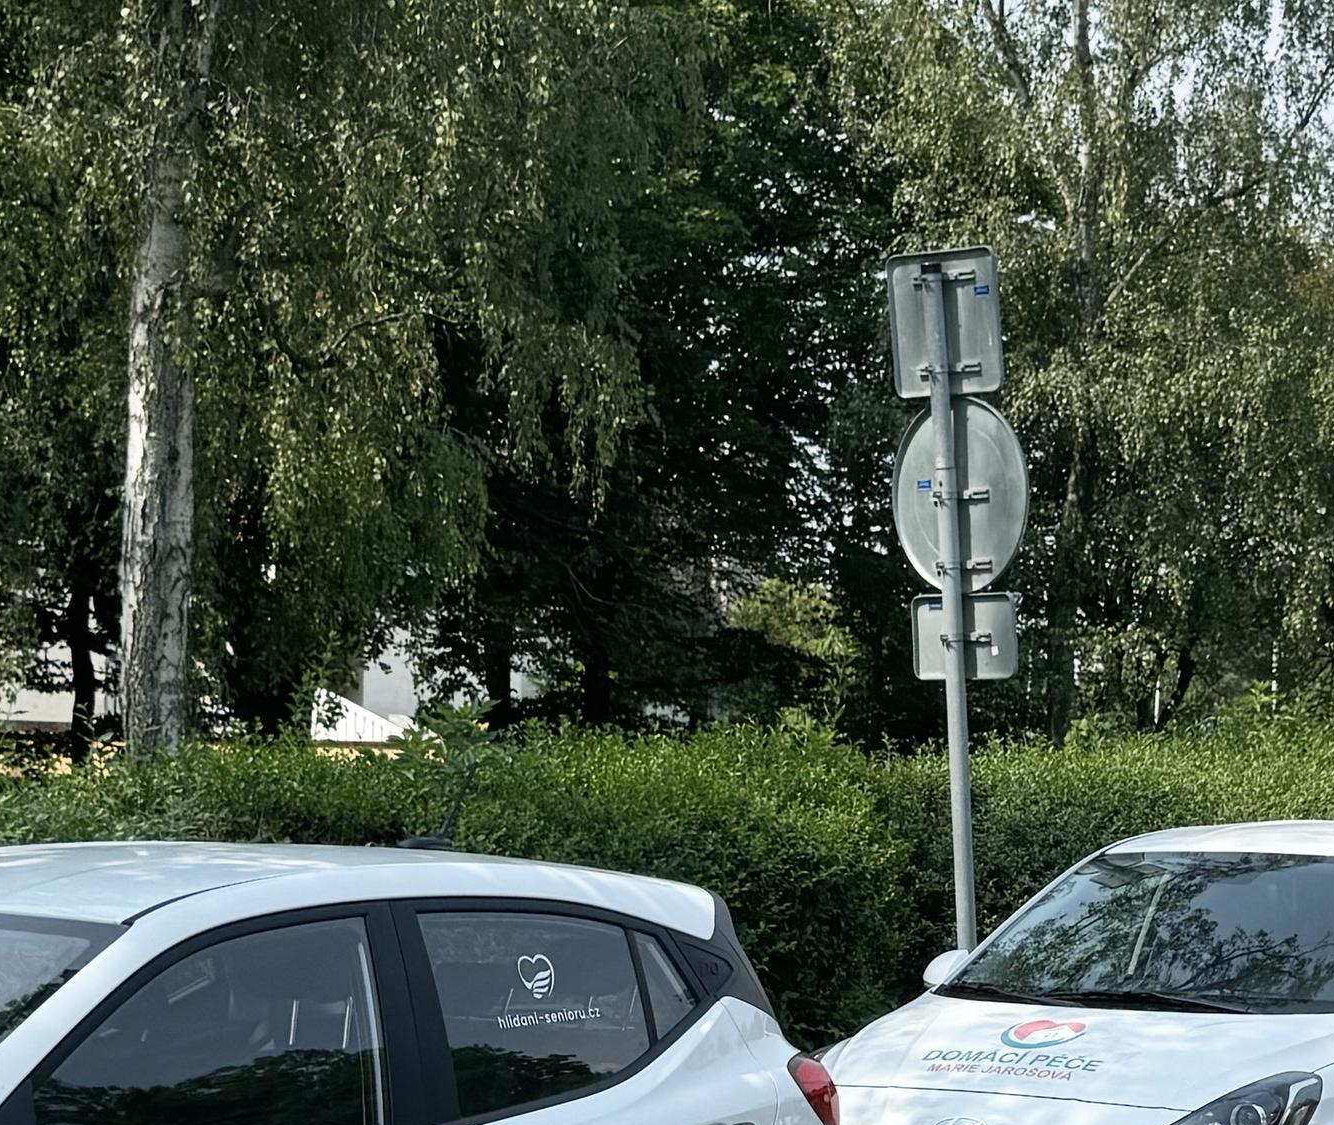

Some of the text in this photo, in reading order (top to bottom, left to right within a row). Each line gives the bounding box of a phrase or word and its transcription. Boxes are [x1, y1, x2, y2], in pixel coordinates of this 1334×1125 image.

[498, 1006, 601, 1029] hlidani-senioru.cz
[923, 1049, 1104, 1073] DOMÁCÍ PÉČE
[926, 1063, 983, 1073] MARIE
